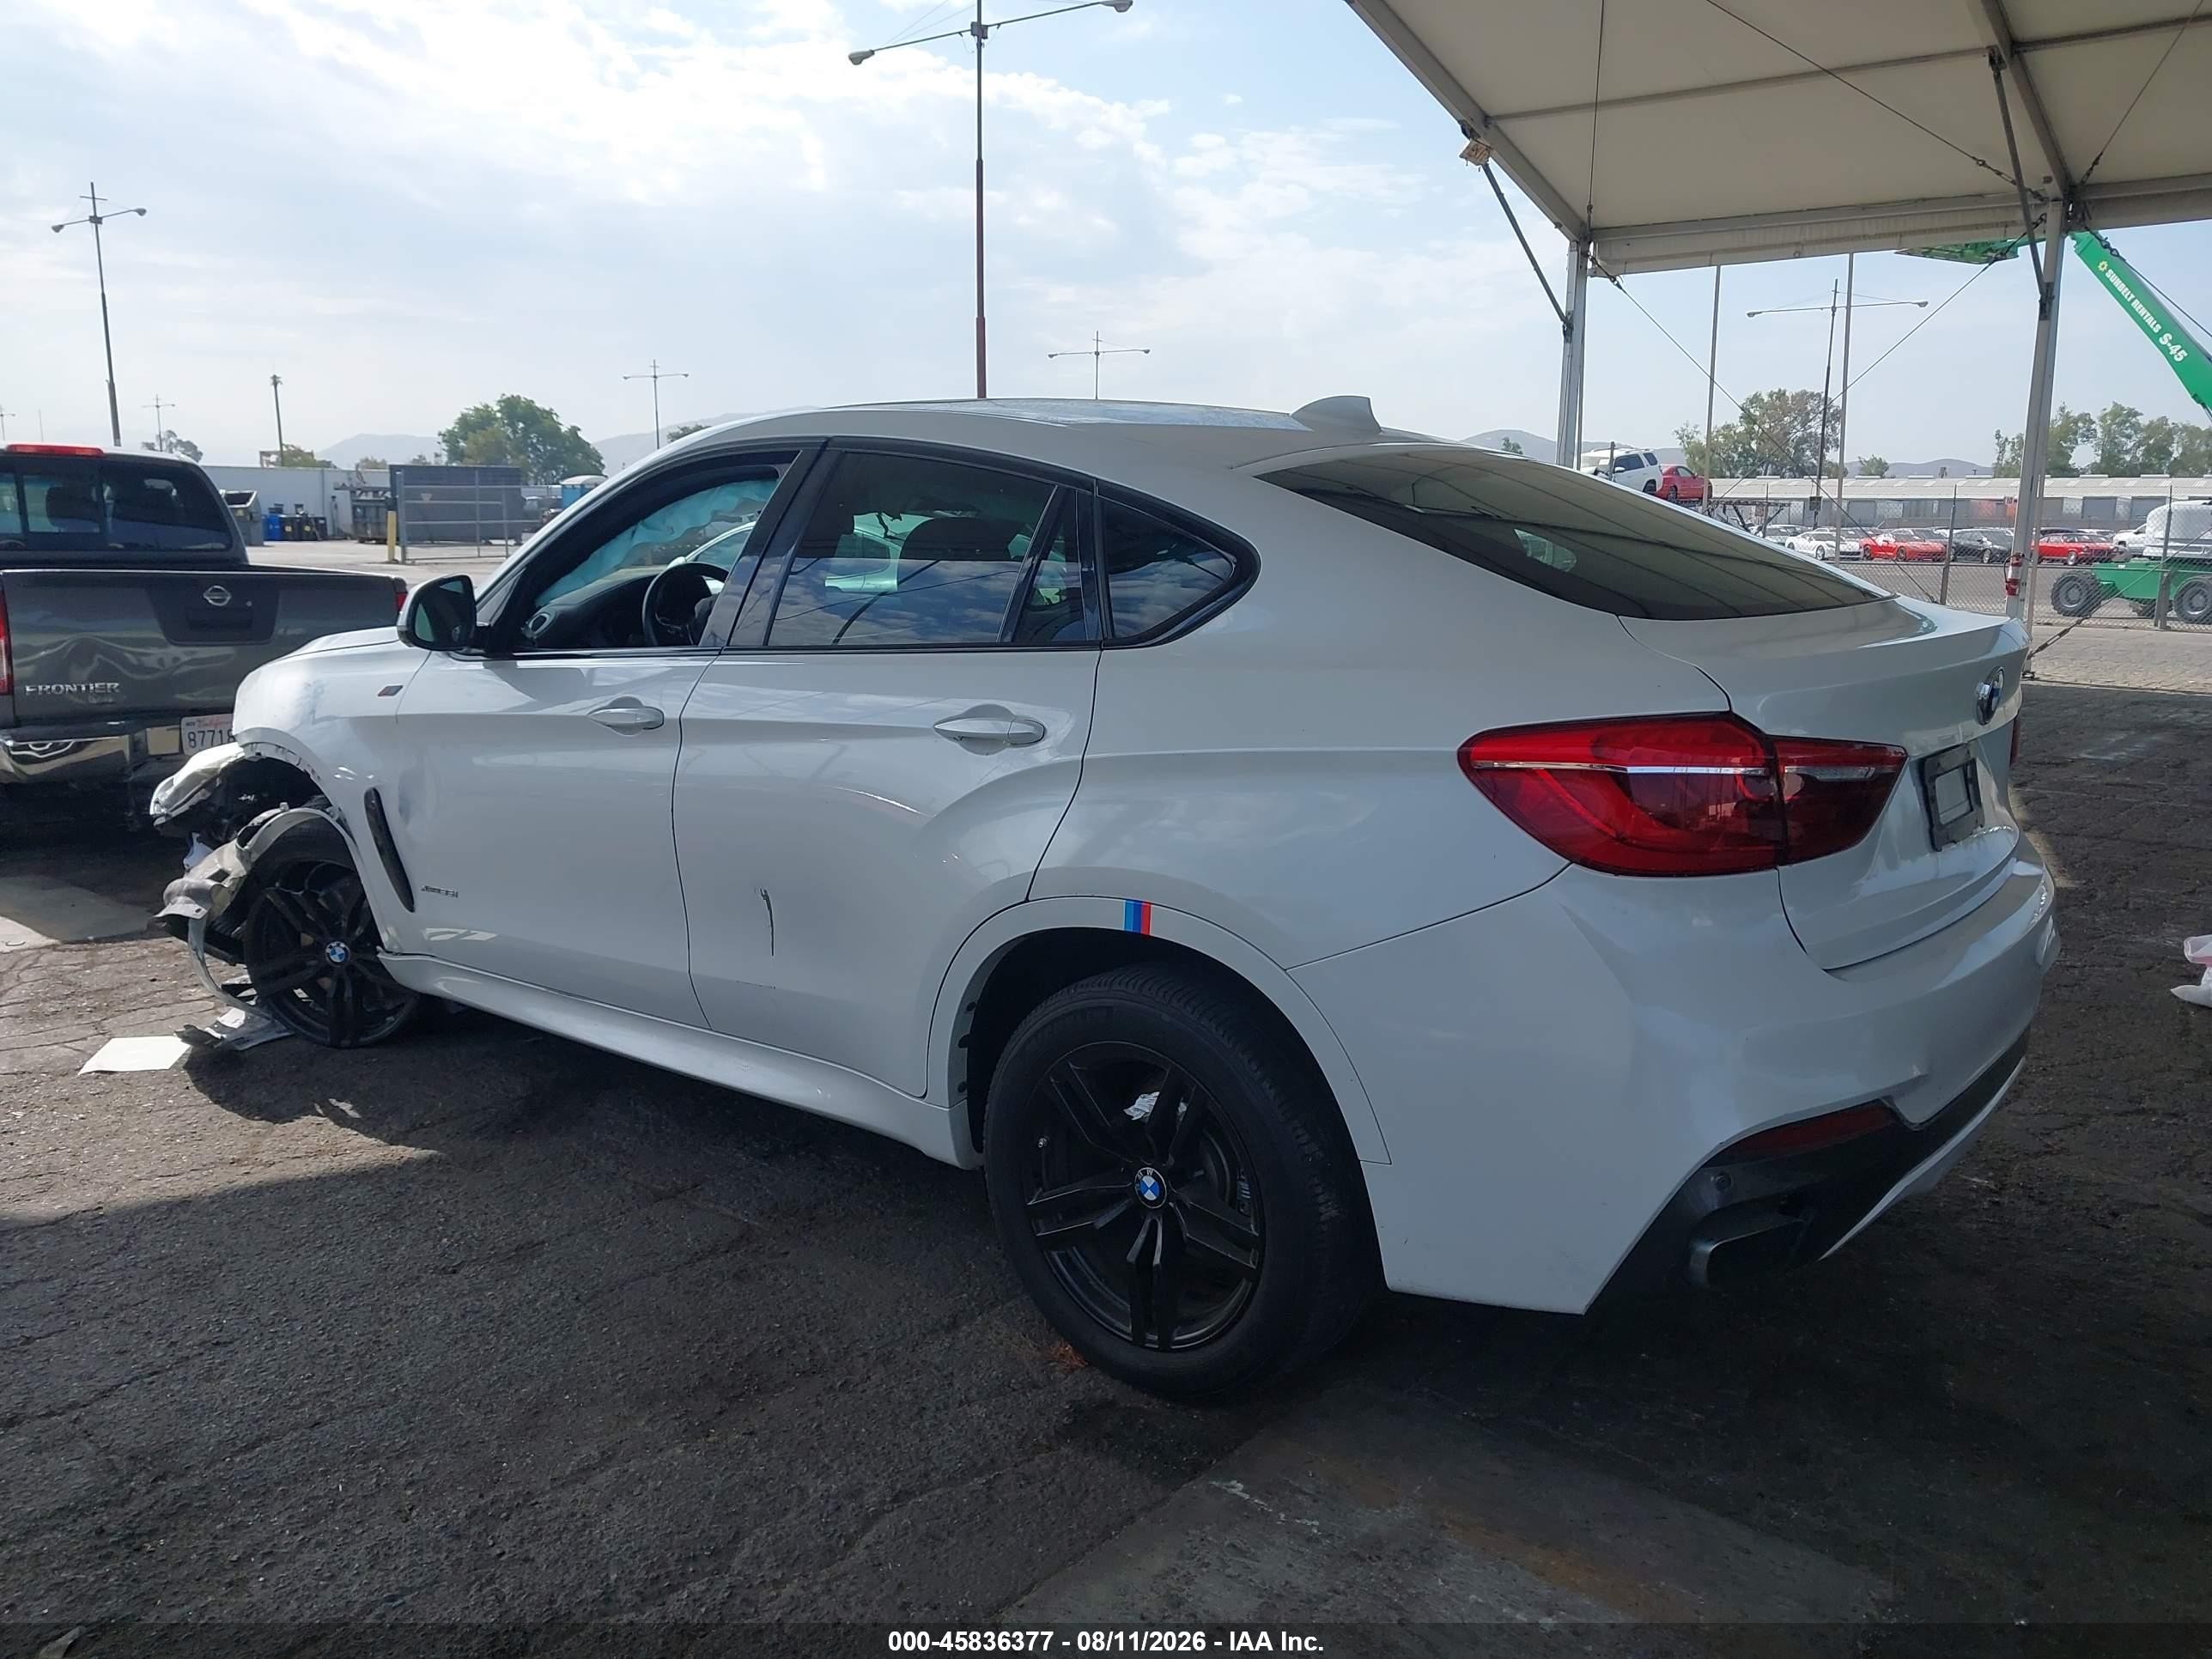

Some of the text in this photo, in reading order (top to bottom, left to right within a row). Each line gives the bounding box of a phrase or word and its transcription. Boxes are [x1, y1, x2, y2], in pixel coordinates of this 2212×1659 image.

[2106, 269, 2188, 362] SUNBELT RENTALS S-45
[25, 682, 119, 696] FRONTIER
